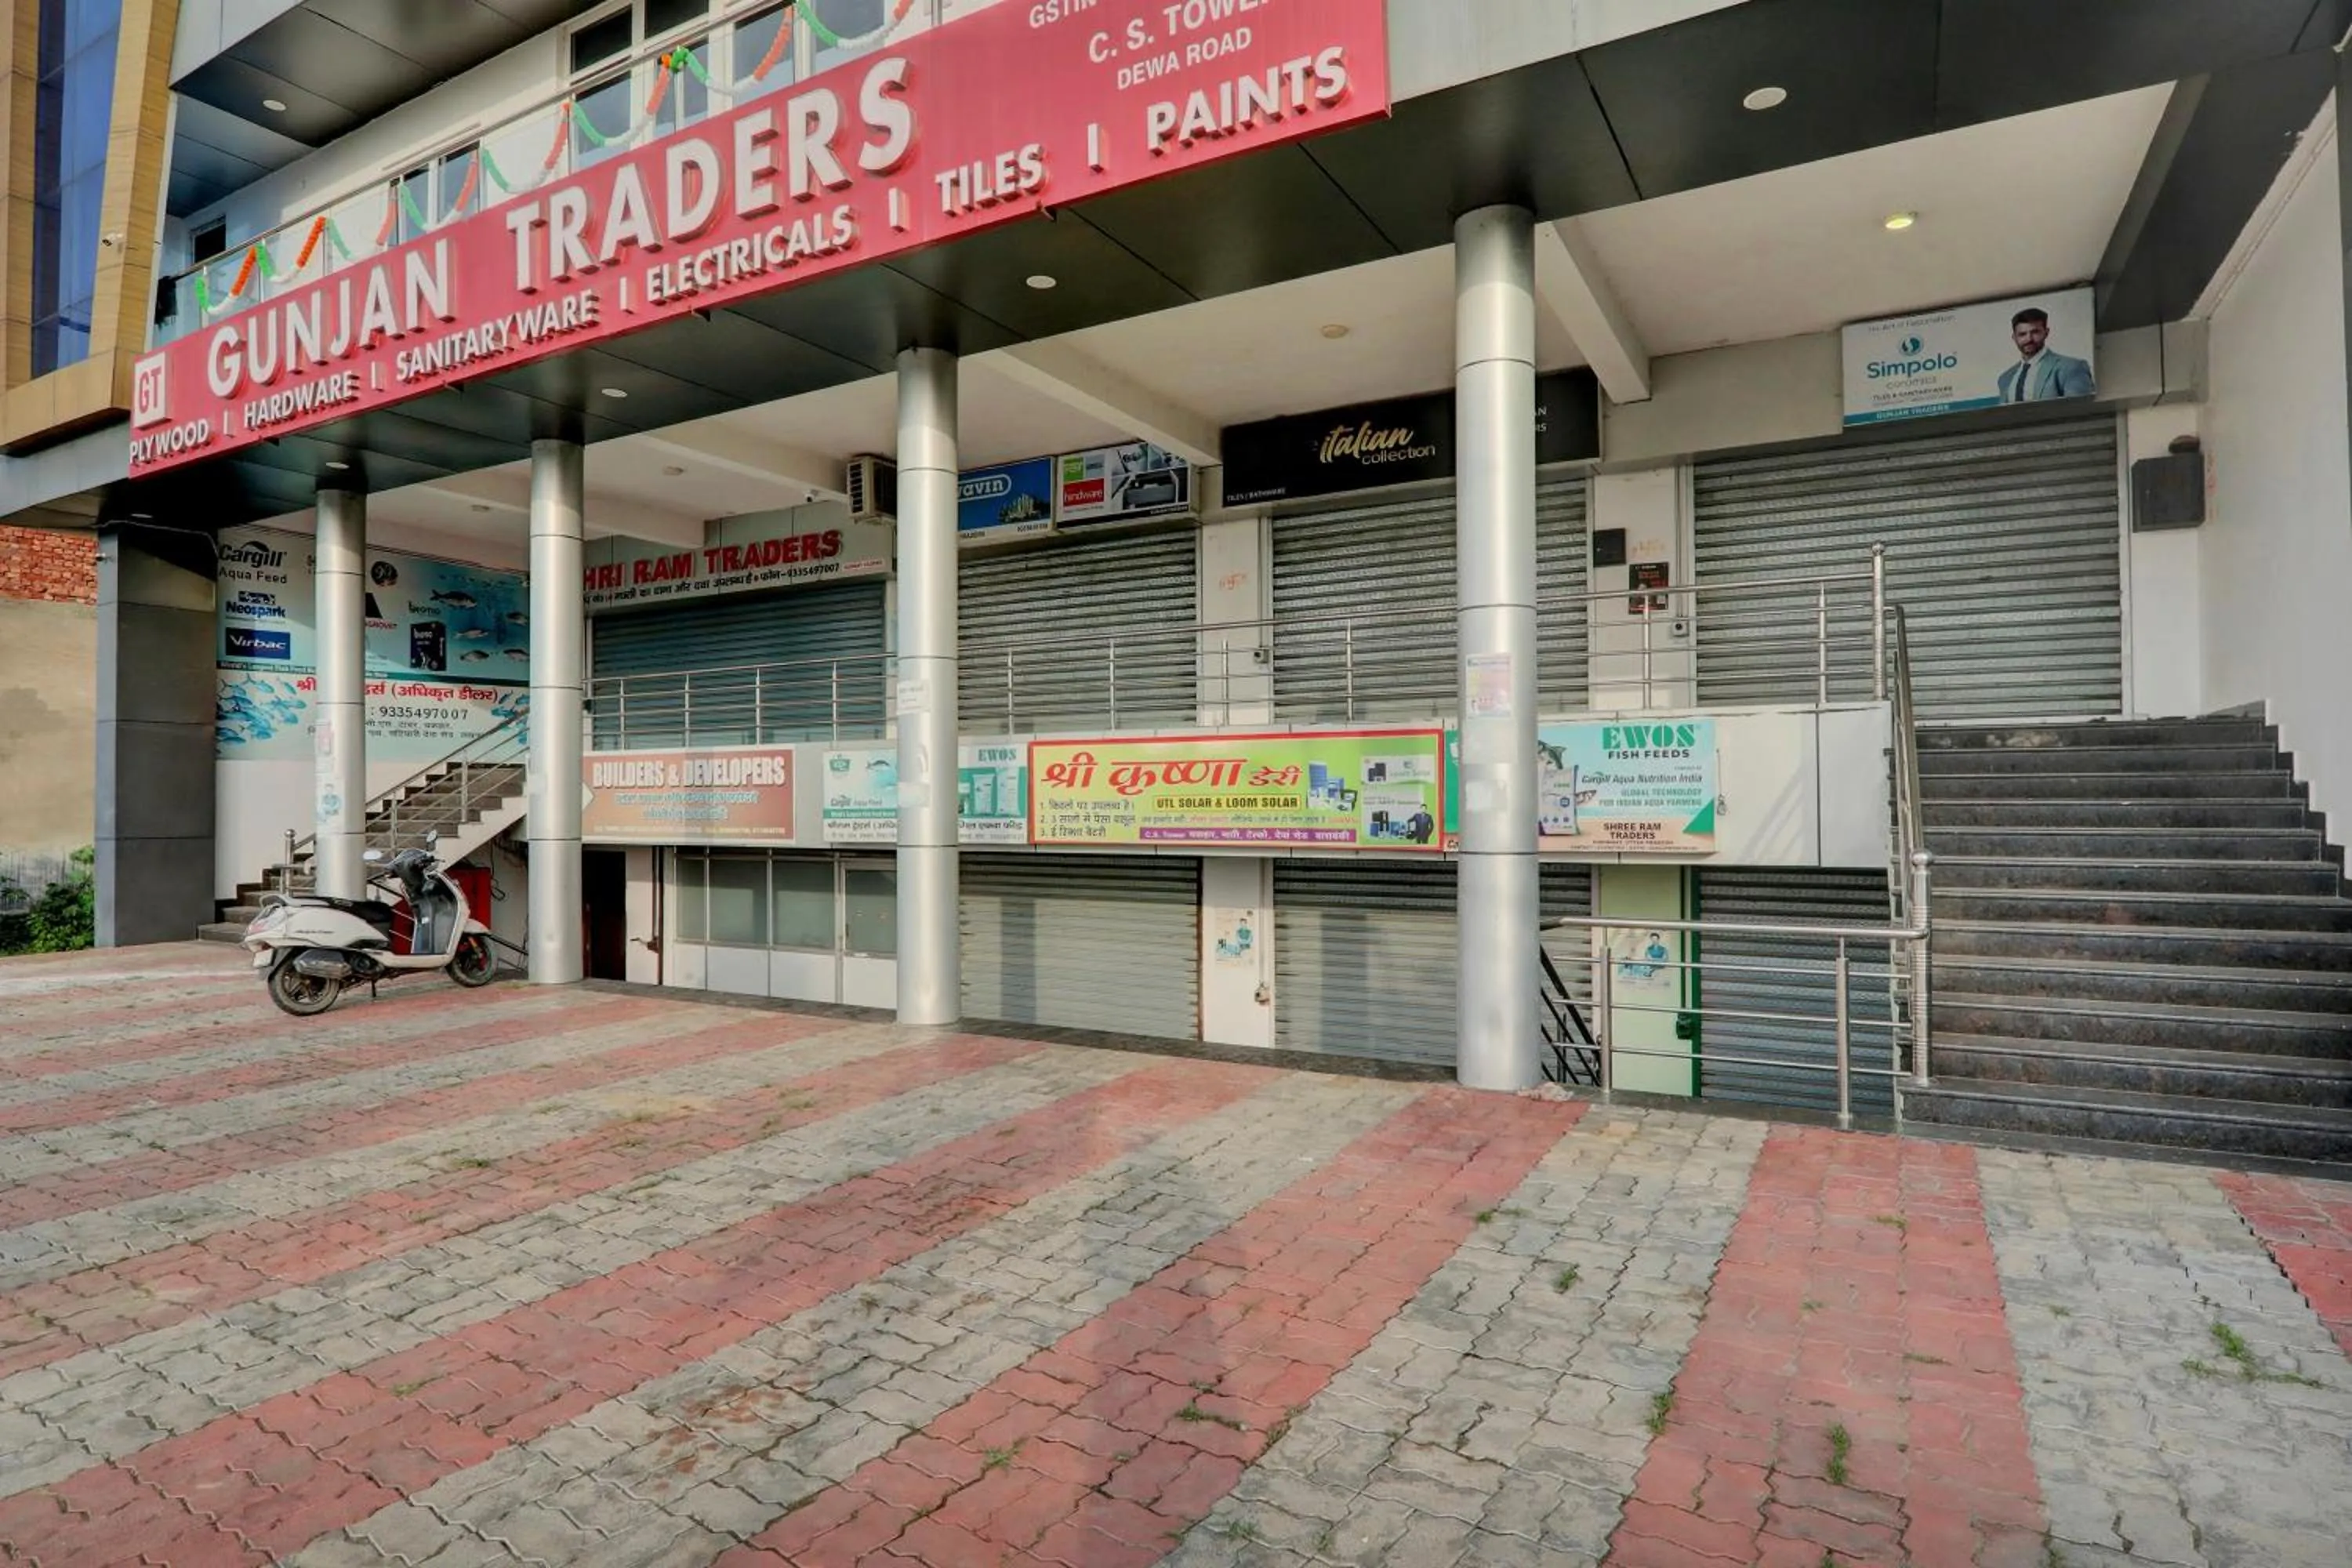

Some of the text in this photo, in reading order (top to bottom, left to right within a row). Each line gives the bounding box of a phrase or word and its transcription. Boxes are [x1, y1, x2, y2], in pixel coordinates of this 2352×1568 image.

[1117, 27, 1251, 90] DEWA ROAD
[207, 57, 914, 397] GUNJAN TRADERS
[129, 417, 209, 464] PLYWOOD
[244, 371, 356, 429] HARDWARE
[396, 292, 595, 382] SANITARYWARE
[647, 205, 855, 303] ELECTRICALS
[935, 144, 1044, 216] TILES
[1147, 47, 1348, 155] PAINTS
[1867, 353, 1957, 379] Simpolo
[140, 365, 162, 414] GT
[1319, 420, 1414, 463] italian
[1362, 445, 1436, 465] collection
[219, 542, 285, 568] Cargill
[583, 530, 842, 590] HRI RAM TRADERS
[219, 566, 288, 584] Aqua Feed
[226, 601, 286, 619] Neospark
[230, 633, 286, 650] Virbac
[296, 677, 316, 691] श्री
[379, 706, 469, 720] 9335497007
[1602, 724, 1697, 750] EWOS
[978, 749, 1017, 762] EWOS
[1608, 749, 1690, 760] FISH FEEDS
[593, 756, 785, 788] BUILDERS & DEVELOPERS
[1040, 751, 1303, 795] श्री कृष्णा डेरी
[1613, 774, 1635, 784] Aqua
[1638, 773, 1678, 783] Nutrition
[1679, 772, 1703, 782] India
[1157, 797, 1298, 808] UTL SOLAR & LOOM SOLAR
[1603, 822, 1637, 831] SHREE
